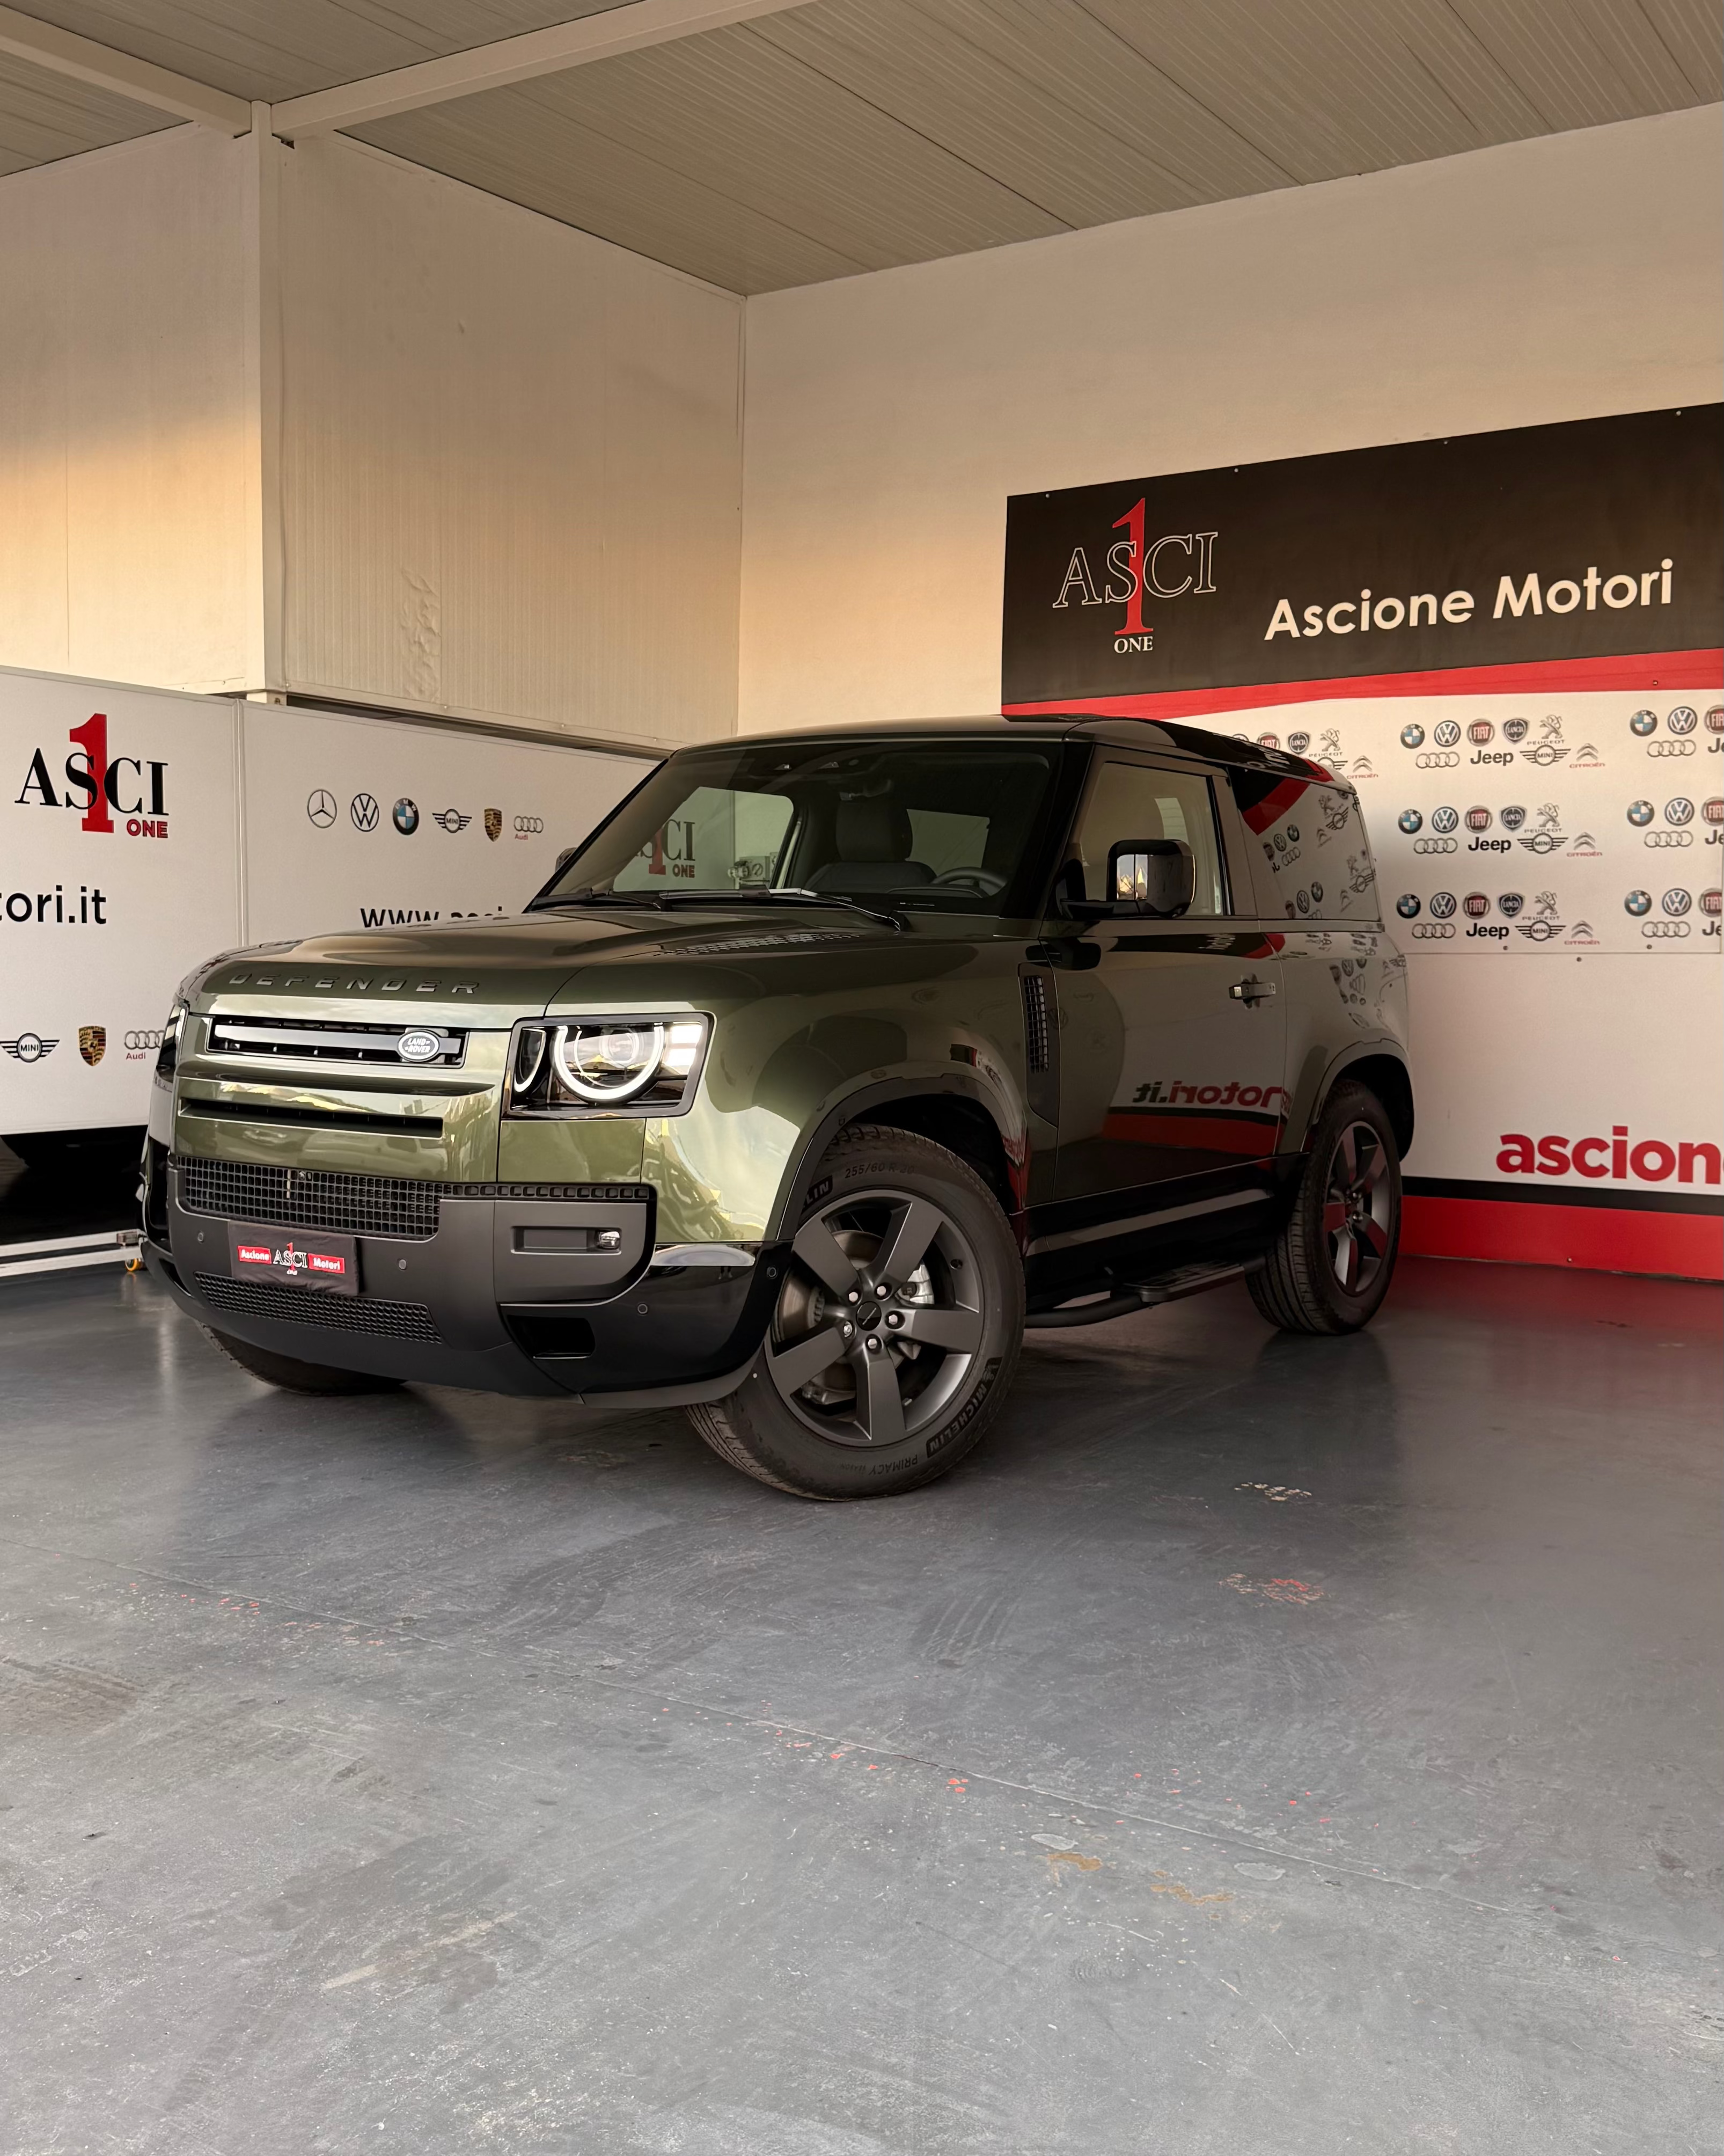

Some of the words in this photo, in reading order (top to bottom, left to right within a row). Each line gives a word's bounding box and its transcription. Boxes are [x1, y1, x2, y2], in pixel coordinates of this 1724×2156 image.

[1053, 532, 1218, 608] ASCI
[1264, 589, 1474, 640] Ascione
[1493, 558, 1673, 619] Motori
[1114, 636, 1154, 654] ONE
[1473, 726, 1490, 740] FIAT
[1470, 750, 1514, 766] Jeep
[14, 748, 169, 815] ASCI
[127, 819, 168, 838] ONE
[1471, 813, 1487, 827] FIAT
[1468, 837, 1512, 853] Jeep
[672, 864, 695, 878] ONE
[0, 885, 107, 924] ori.it
[1469, 900, 1485, 912] FIAT
[1466, 923, 1509, 939] Jeep
[229, 973, 479, 993] DEFENDER
[20, 1044, 39, 1052] MINI
[126, 1052, 146, 1060] Audi
[1496, 1125, 1724, 1185] ascion
[845, 1163, 885, 1179] 255/60
[241, 1249, 269, 1261] Ascione
[273, 1249, 307, 1268] ASCI
[313, 1258, 341, 1270] Motori
[929, 1383, 987, 1452] MICHELIN
[869, 1454, 918, 1475] PRIMACY
